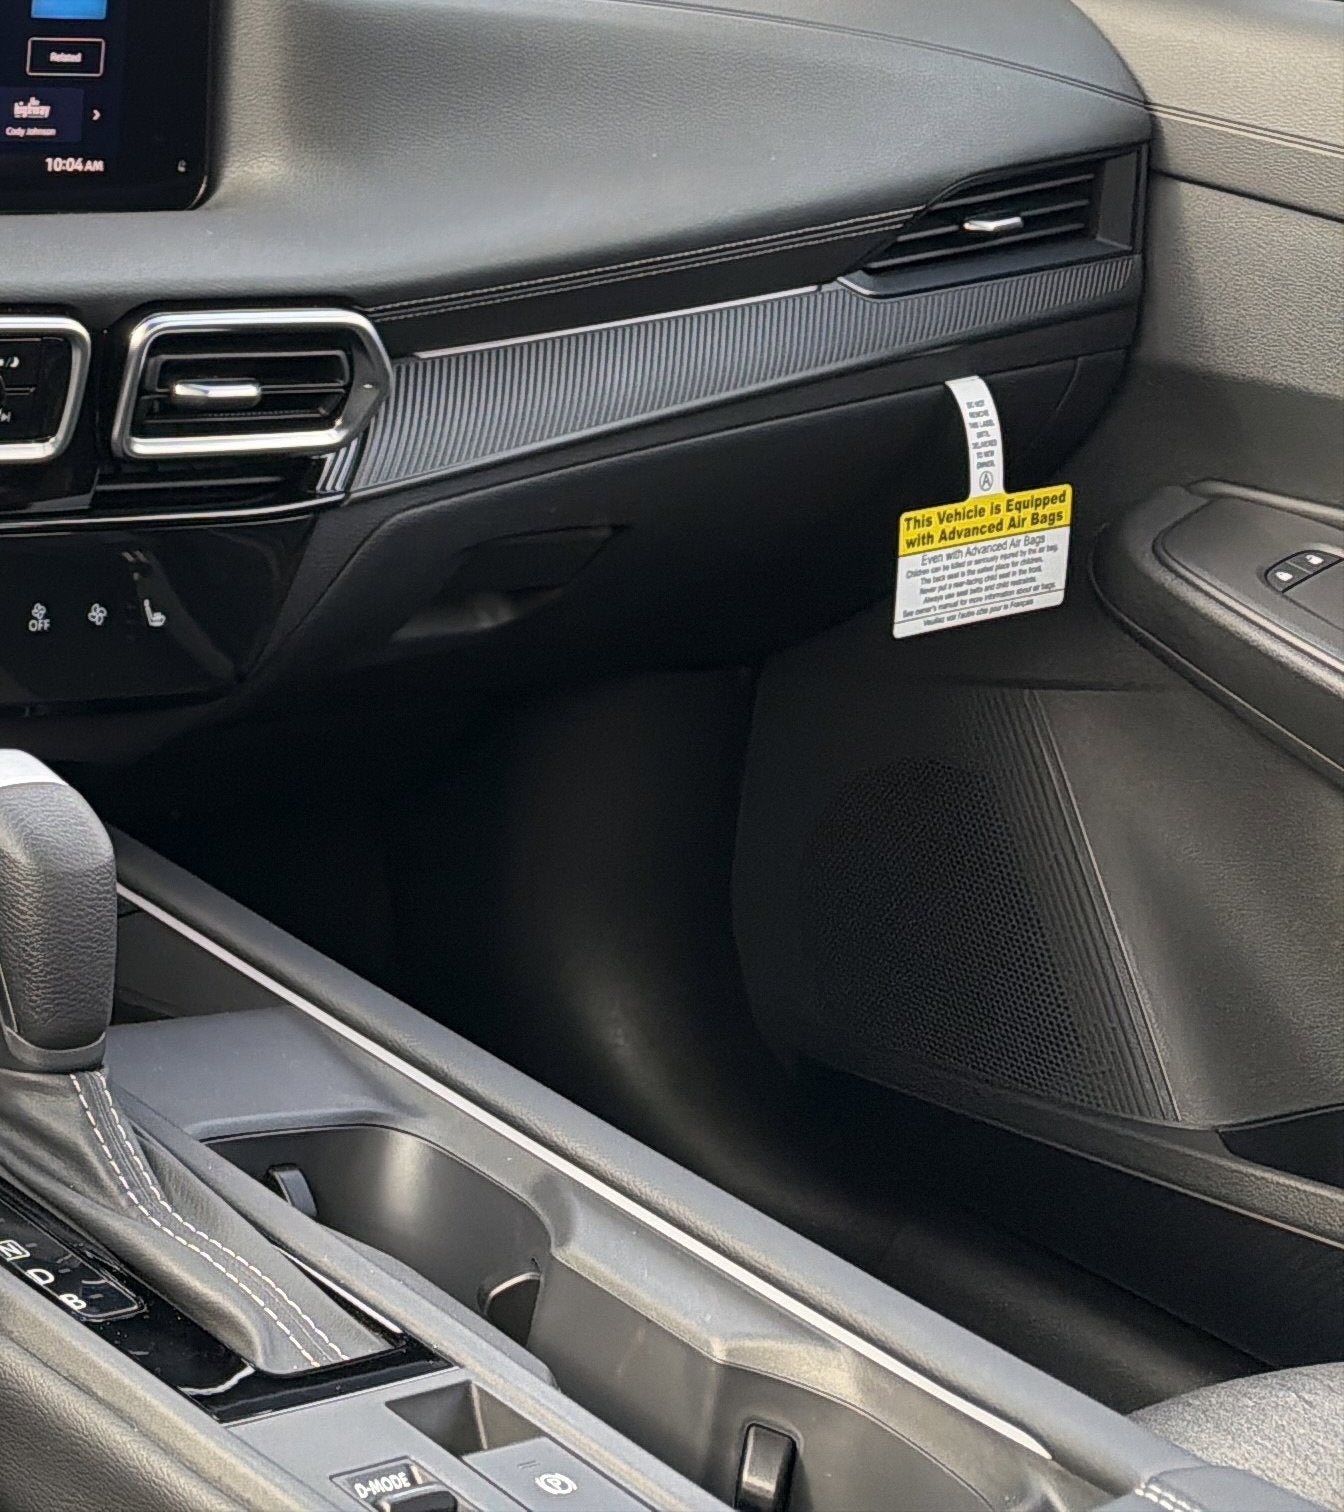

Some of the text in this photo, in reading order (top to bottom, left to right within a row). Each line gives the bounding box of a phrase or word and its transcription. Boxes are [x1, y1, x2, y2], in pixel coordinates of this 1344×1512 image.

[45, 157, 104, 172] 10:04 AM
[904, 490, 1066, 532] This Vehicle is Equipped
[906, 510, 1064, 549] with Advanced Air Bags
[921, 534, 1046, 566] Even with Advanced Air Bags
[28, 619, 51, 631] OFF
[25, 1268, 55, 1285] D
[59, 1293, 87, 1310] B
[354, 1471, 411, 1499] D-MODE
